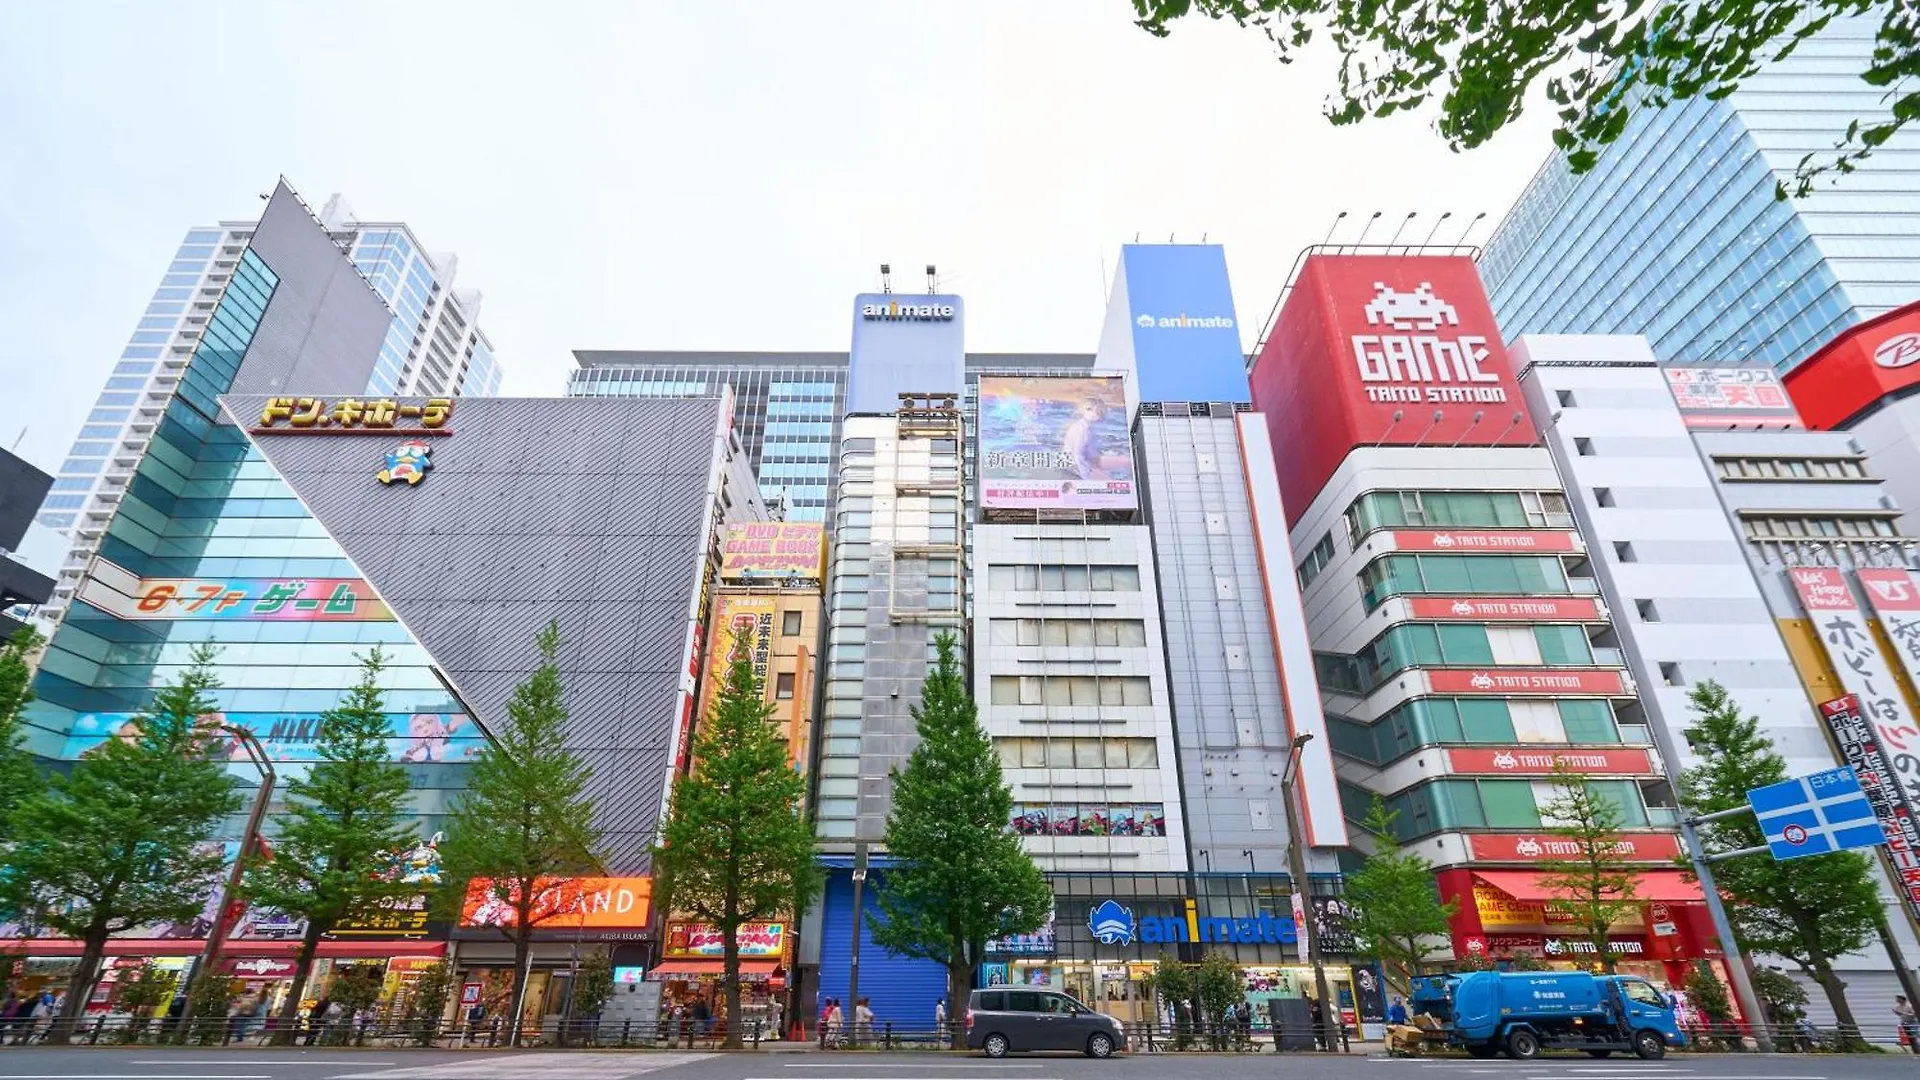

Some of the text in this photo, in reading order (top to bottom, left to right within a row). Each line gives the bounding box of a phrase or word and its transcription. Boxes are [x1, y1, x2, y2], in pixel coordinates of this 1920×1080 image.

[862, 300, 955, 319] animate
[1158, 312, 1234, 329] animate
[1351, 335, 1500, 382] GAME
[1697, 370, 1774, 383] ボークス
[1365, 386, 1507, 403] TAITO STATION
[1720, 385, 1787, 407] 天国
[1456, 536, 1536, 547] TAITO STATION
[252, 579, 356, 614] ゲーム
[1474, 603, 1556, 614] TAITO STATION
[1494, 676, 1581, 688] TAITO STATION
[1518, 755, 1553, 768] TAITO
[1543, 841, 1580, 854] TAITO
[1140, 898, 1298, 945] animate
[1566, 941, 1598, 954] TAITO
